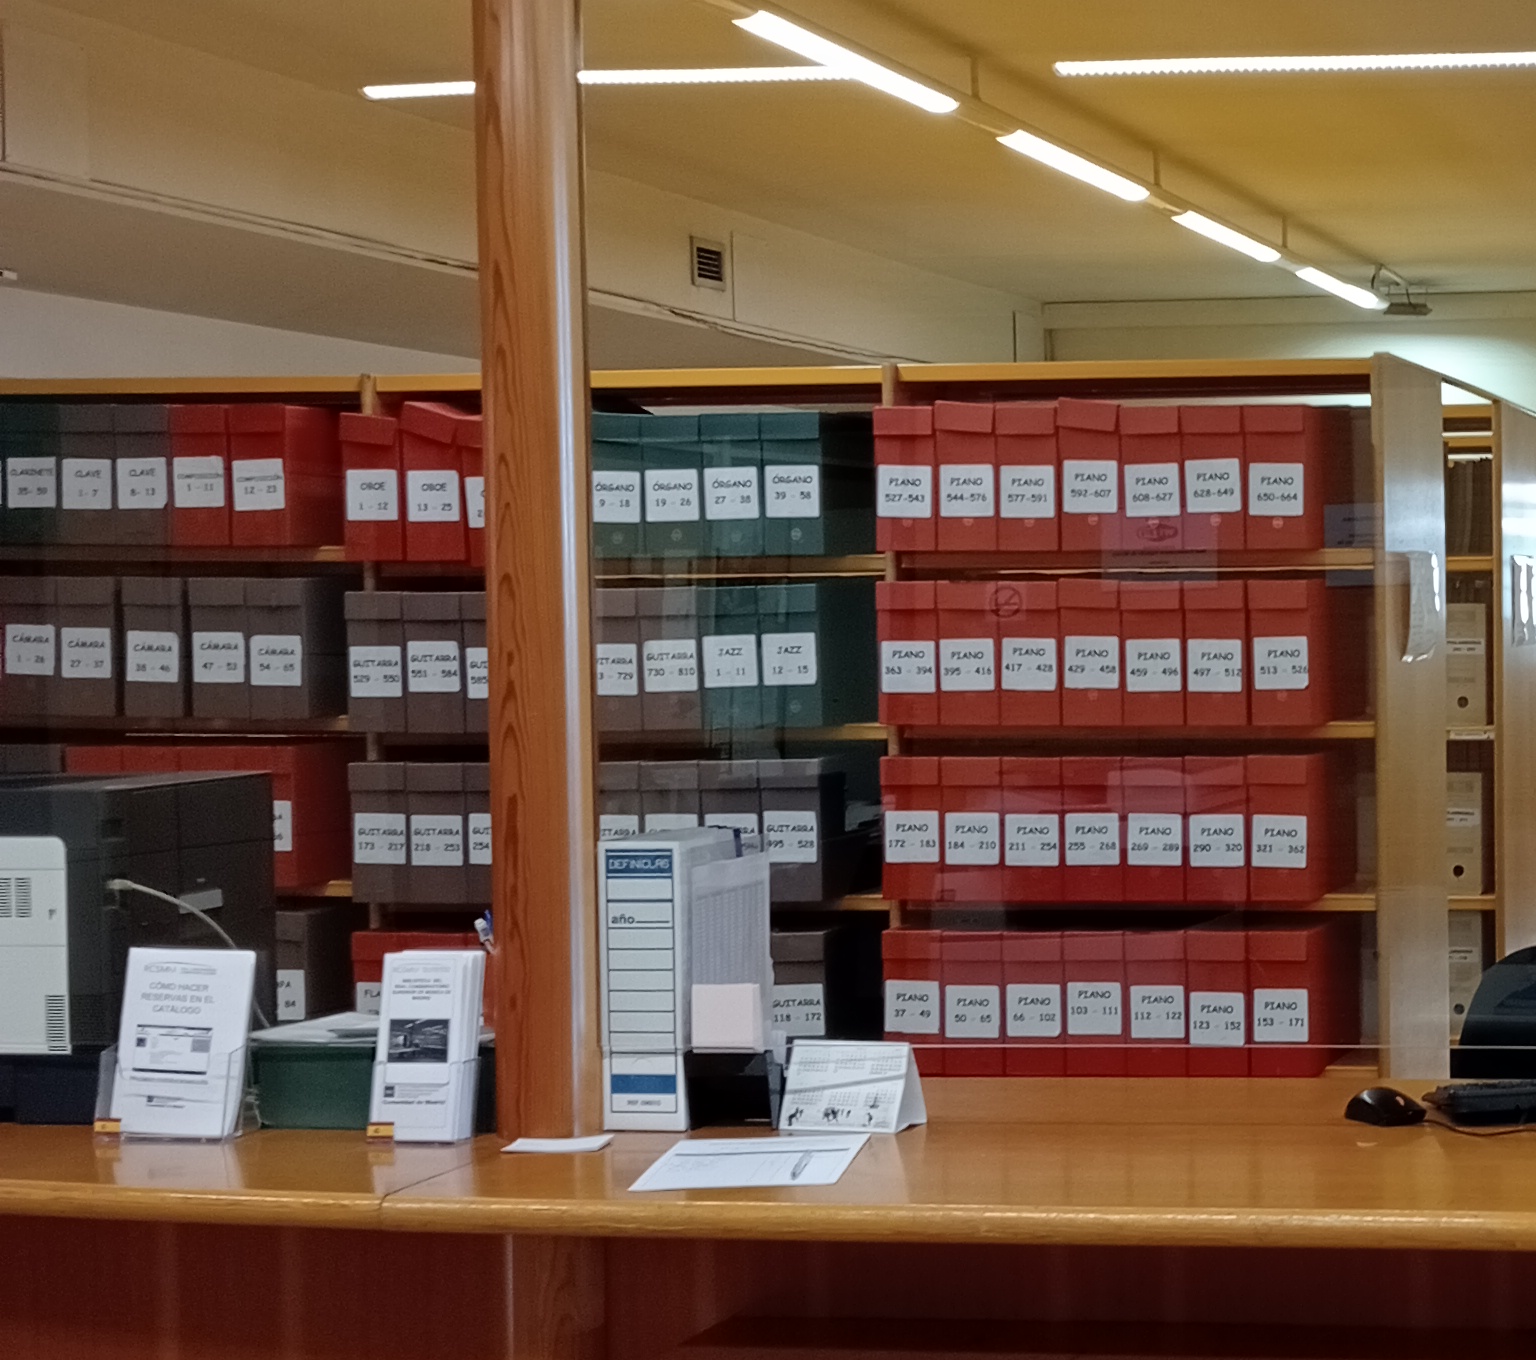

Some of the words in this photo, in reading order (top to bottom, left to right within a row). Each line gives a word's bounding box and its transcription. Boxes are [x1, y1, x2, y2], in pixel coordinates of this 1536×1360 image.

[75, 470, 101, 478] CLAVE
[129, 468, 155, 477] CLAVE
[1197, 472, 1229, 481] PIANO
[772, 475, 813, 484] ÓRGANO
[950, 478, 983, 486] PIANO
[1012, 478, 1044, 486] PIANO
[1075, 473, 1107, 482] PIANO
[1136, 477, 1168, 486] PIANO
[1261, 477, 1294, 485] PIANO
[360, 482, 385, 491] OBOE
[422, 483, 447, 491] OBOE
[595, 482, 635, 492] ÓRGANO
[653, 481, 692, 491] ÓRGANO
[712, 479, 752, 489] ÓRGANO
[889, 478, 921, 487] PIANO
[800, 491, 811, 499] 58
[1071, 489, 1111, 498] 592-607
[1132, 493, 1173, 502] 608-627
[1193, 488, 1234, 498] 628-649
[1257, 493, 1297, 501] 650-664
[885, 494, 924, 502] 527-543
[947, 494, 986, 502] 544-576
[1008, 494, 1047, 502] 577-591
[656, 499, 666, 507] 19
[68, 638, 105, 648] CÁMARA
[134, 642, 172, 652] CÁMARA
[200, 641, 238, 651] CÁMARA
[258, 646, 295, 656] CÁMARA
[718, 648, 742, 656] JAZZ
[777, 646, 801, 654] JAZZ
[892, 650, 925, 659] PIANO
[1013, 648, 1045, 656] PIANO
[1076, 649, 1108, 657] PIANO
[1268, 649, 1300, 658] PIANO
[410, 654, 457, 663] GUITARRA
[646, 652, 694, 661] GUITARRA
[951, 651, 984, 659] PIANO
[1138, 652, 1170, 660] PIANO
[1201, 652, 1234, 660] PIANO
[353, 659, 399, 668] GUITARRA
[1005, 663, 1022, 671] 417
[1036, 664, 1053, 672] 428
[647, 668, 665, 677] 730
[678, 668, 695, 677] 810
[773, 666, 783, 674] 12
[798, 665, 808, 673] 15
[885, 666, 902, 674] 363
[916, 666, 933, 674] 394
[944, 667, 961, 676] 395
[975, 667, 991, 675] 416
[1068, 665, 1085, 673] 429
[1100, 665, 1116, 673] 458
[1130, 668, 1147, 676] 459
[1162, 668, 1179, 677] 496
[1193, 668, 1211, 676] 497
[1260, 666, 1277, 674] 513
[358, 828, 405, 836] GUITARRA
[414, 828, 460, 836] GUITARRA
[766, 824, 814, 833] GUITARRA
[896, 824, 928, 832] PIANO
[955, 825, 988, 834] PIANO
[1017, 827, 1049, 835] PIANO
[1075, 826, 1108, 834] PIANO
[1139, 827, 1171, 835] PIANO
[1201, 828, 1234, 836] PIANO
[1264, 828, 1297, 837] PIANO
[359, 842, 375, 850] 173
[889, 840, 906, 848] 172
[949, 841, 964, 849] 184
[979, 841, 996, 849] 210
[1009, 842, 1025, 851] 211
[1068, 842, 1085, 850] 255
[1099, 842, 1116, 850] 268
[1131, 843, 1148, 851] 269
[1162, 843, 1180, 852] 289
[1194, 844, 1211, 852] 290
[1225, 843, 1243, 852] 320
[1257, 844, 1272, 853] 321
[1288, 845, 1305, 854] 362
[611, 914, 635, 924] año
[896, 993, 929, 1002] PIANO
[1078, 991, 1111, 999] PIANO
[772, 999, 820, 1008] GUITARRA
[957, 998, 989, 1007] PIANO
[1018, 997, 1051, 1005] PIANO
[1142, 996, 1174, 1004] PIANO
[1071, 1006, 1088, 1015] 103
[1103, 1007, 1117, 1015] 111
[1201, 1005, 1233, 1014] PIANO
[1264, 1002, 1297, 1010] PIANO
[805, 1013, 822, 1022] 172
[895, 1009, 906, 1017] 37
[920, 1010, 931, 1018] 49
[955, 1014, 966, 1022] 50
[1040, 1013, 1056, 1021] 102
[1135, 1012, 1151, 1020] 112
[1166, 1012, 1182, 1020] 122
[1194, 1021, 1210, 1029] 123
[1225, 1021, 1241, 1030] 152
[1258, 1018, 1274, 1026] 153
[1289, 1018, 1304, 1027] 171
